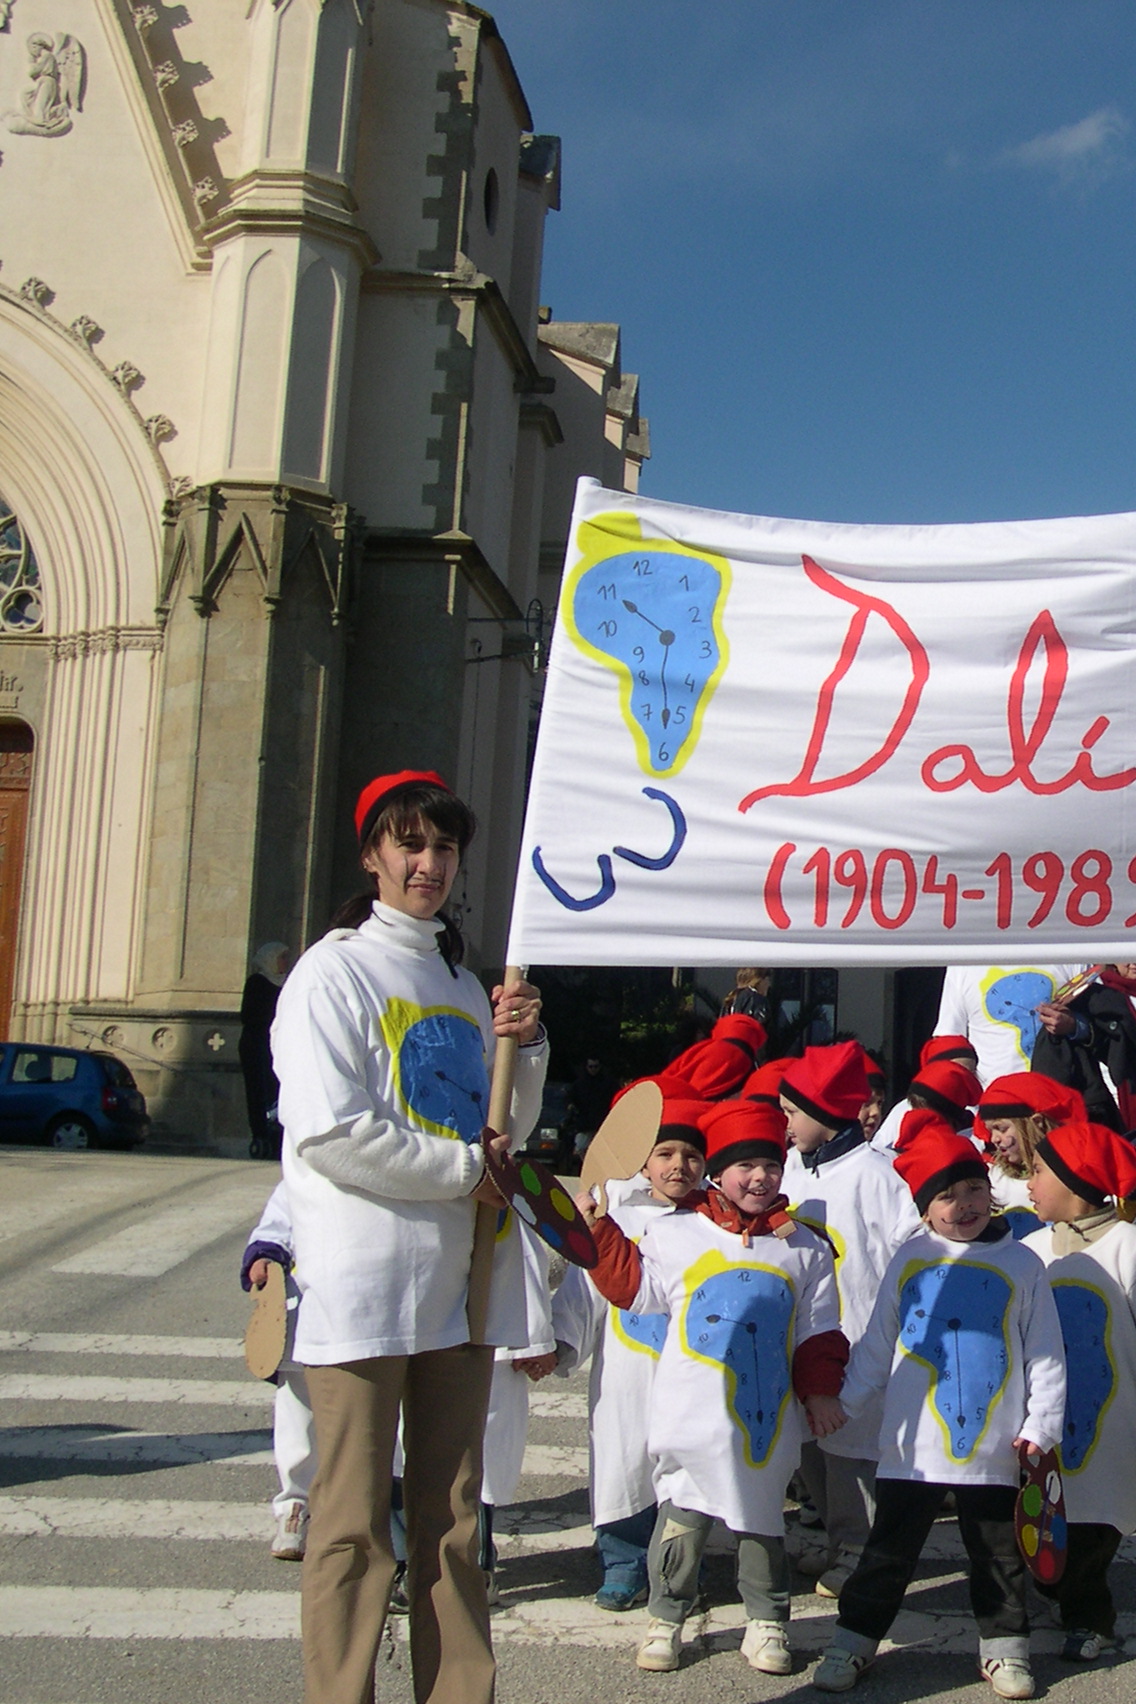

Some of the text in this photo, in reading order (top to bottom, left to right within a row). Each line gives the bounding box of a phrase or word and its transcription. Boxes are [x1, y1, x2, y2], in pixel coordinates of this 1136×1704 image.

[632, 559, 652, 577] 12
[679, 575, 690, 592] 1
[597, 583, 617, 600] 11
[688, 606, 701, 624] 2
[597, 619, 618, 638] 10
[632, 646, 645, 664] 9
[699, 640, 713, 660] 3
[638, 670, 650, 687] 8
[684, 673, 696, 693] 4
[640, 703, 653, 722] 7
[672, 705, 686, 725] 5
[658, 742, 670, 763] 6
[737, 1271, 752, 1283] 12
[935, 1269, 947, 1280] 12
[906, 1323, 917, 1335] 10
[992, 1315, 1001, 1329] 2
[698, 1332, 709, 1344] 10
[725, 1348, 736, 1361] 9
[740, 1373, 748, 1386] 8
[943, 1369, 952, 1381] 8
[986, 1381, 994, 1395] 4
[769, 1411, 776, 1425] 5
[975, 1407, 985, 1421] 5
[755, 1435, 763, 1450] 6
[957, 1436, 966, 1450] 6
